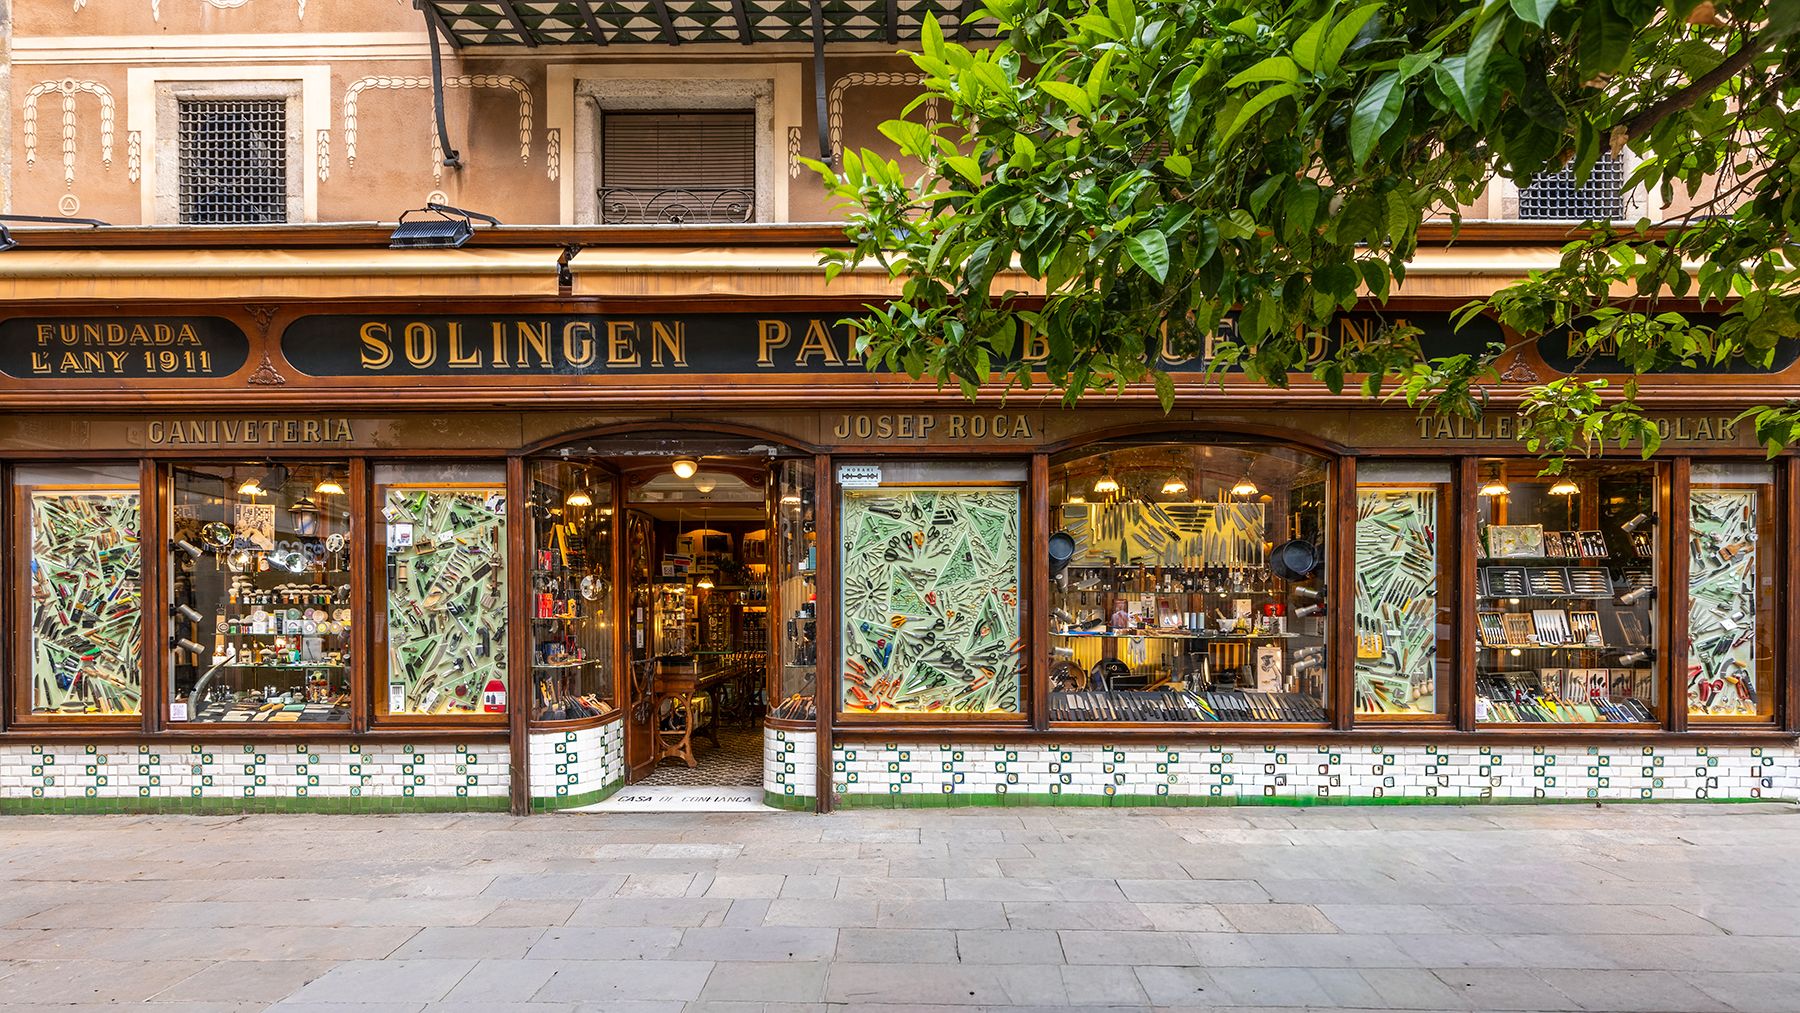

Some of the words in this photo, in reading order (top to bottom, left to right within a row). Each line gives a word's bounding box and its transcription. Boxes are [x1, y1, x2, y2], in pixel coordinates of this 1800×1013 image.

[36, 323, 202, 347] FUNDADA
[360, 321, 689, 369] SOLINGEN
[143, 351, 213, 373] 1911
[834, 414, 936, 439] JOSEP
[948, 414, 1033, 439] ROCA
